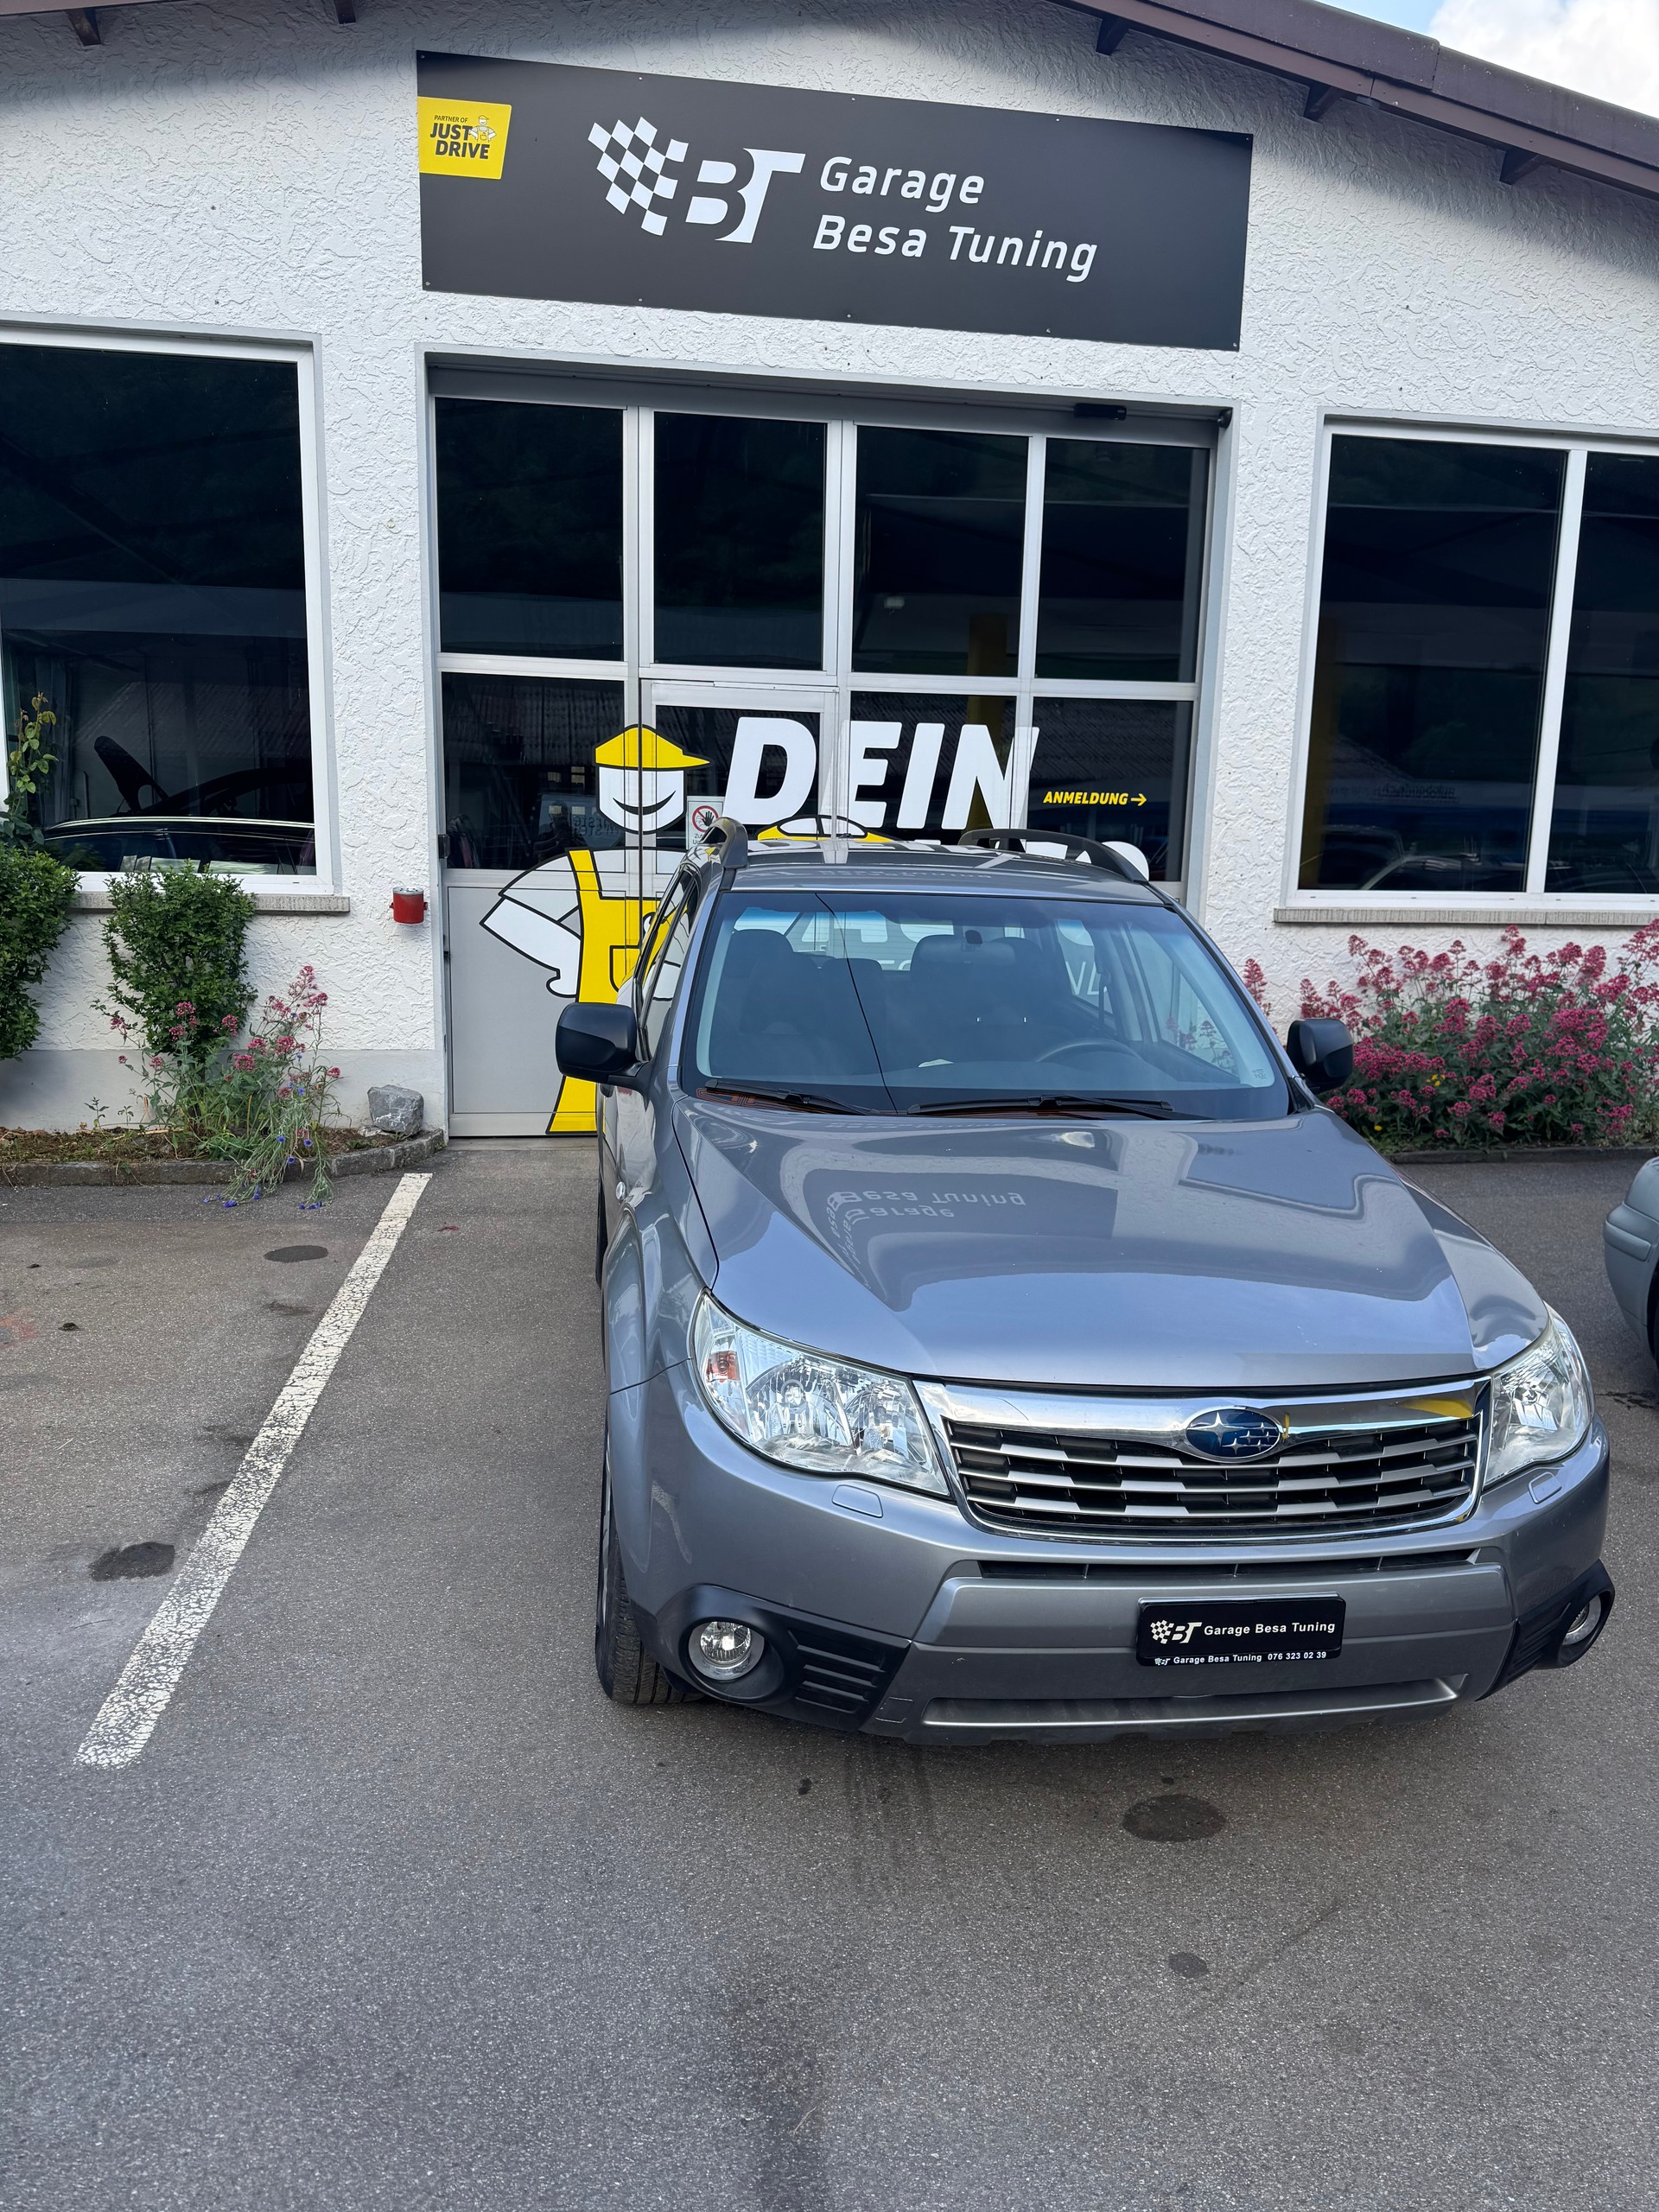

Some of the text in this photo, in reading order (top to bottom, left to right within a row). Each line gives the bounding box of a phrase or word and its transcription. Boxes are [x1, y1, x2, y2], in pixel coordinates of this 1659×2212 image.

[434, 114, 460, 123] PARTNER
[429, 122, 473, 141] JUST
[435, 139, 491, 159] DRIVE
[820, 156, 985, 213] Garage
[812, 214, 1098, 283] Besa Tuning
[723, 716, 1039, 830] DEIN
[1043, 791, 1128, 805] ANMELDUNG
[1204, 1625, 1250, 1637] Garage
[1255, 1623, 1287, 1634] Besa
[1292, 1621, 1336, 1634] Tuning
[1173, 1656, 1205, 1665] Garage
[1207, 1655, 1230, 1663] Besa
[1232, 1654, 1262, 1663] Tuning
[1268, 1652, 1283, 1661] 076
